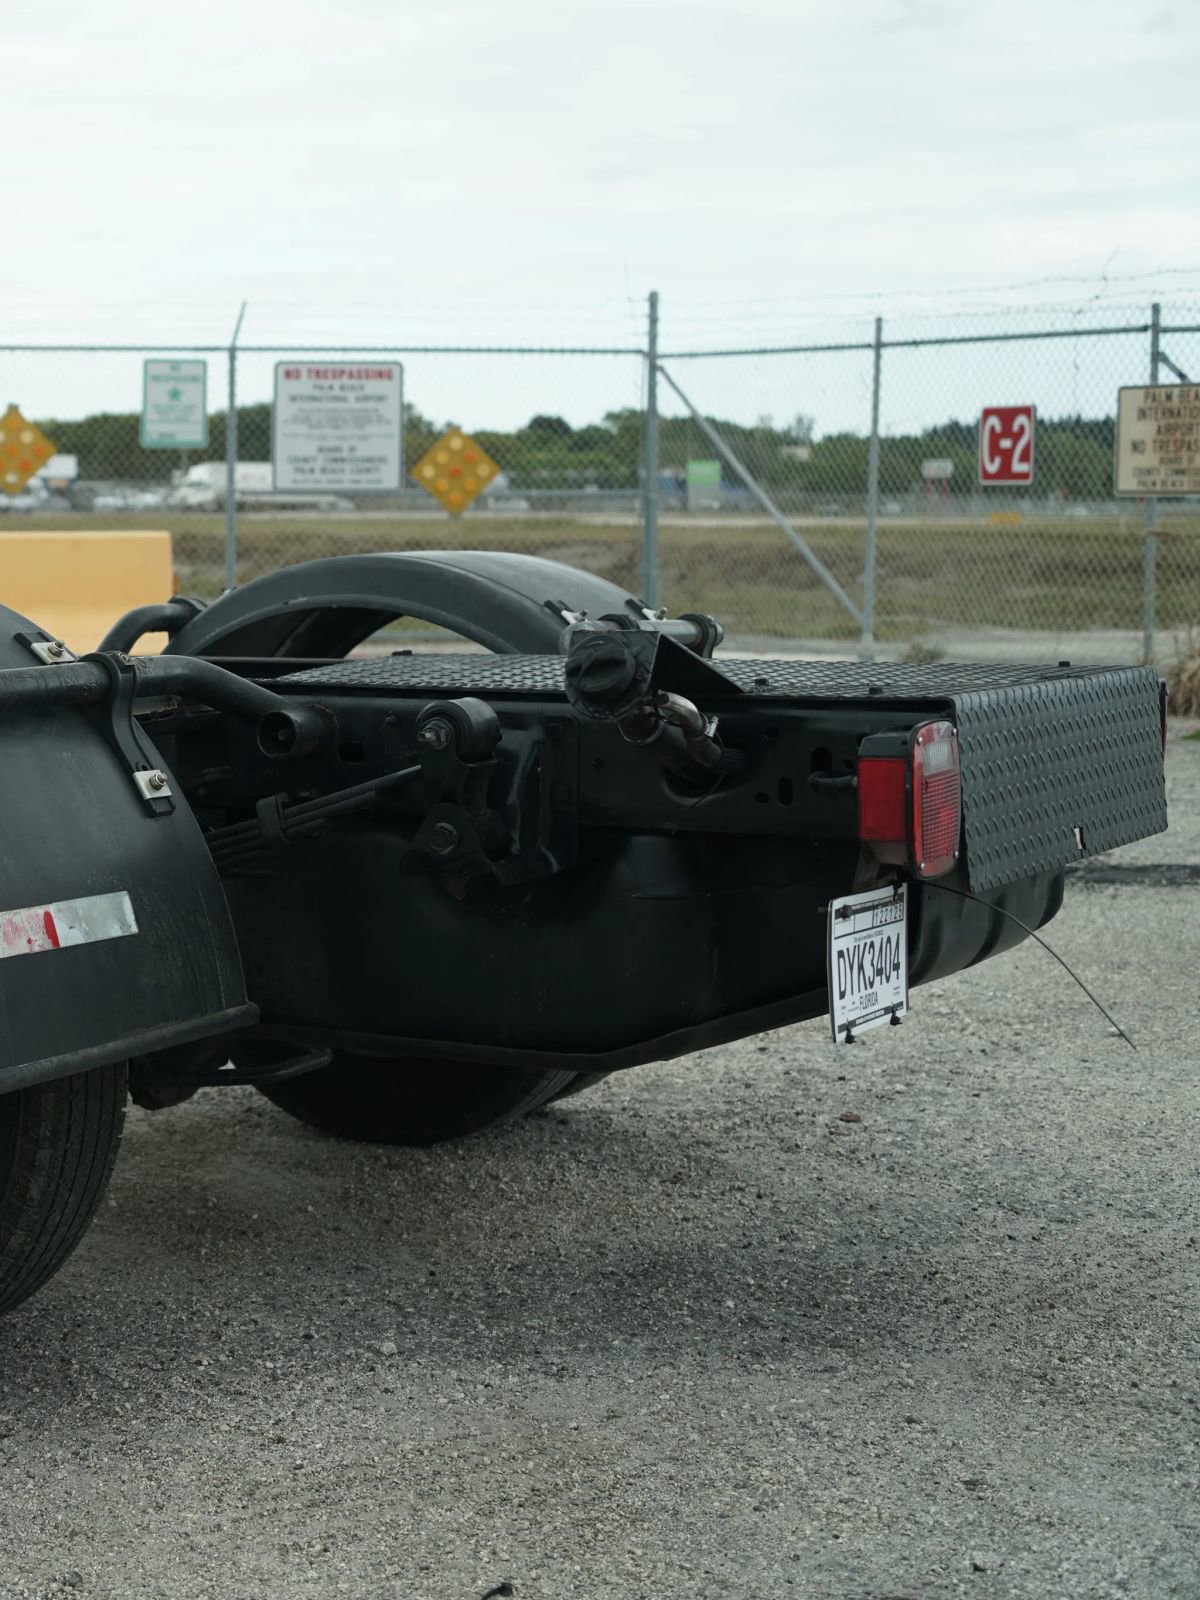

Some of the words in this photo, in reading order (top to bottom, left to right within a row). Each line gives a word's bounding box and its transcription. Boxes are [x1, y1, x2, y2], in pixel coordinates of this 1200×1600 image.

[283, 368, 302, 380] NO
[307, 367, 393, 380] TRESPASSING
[1143, 388, 1173, 404] PALM
[982, 414, 1031, 474] C-2
[1131, 440, 1146, 455] NO
[836, 932, 901, 1001] DYK3404
[859, 990, 879, 1012] FLORIDA
